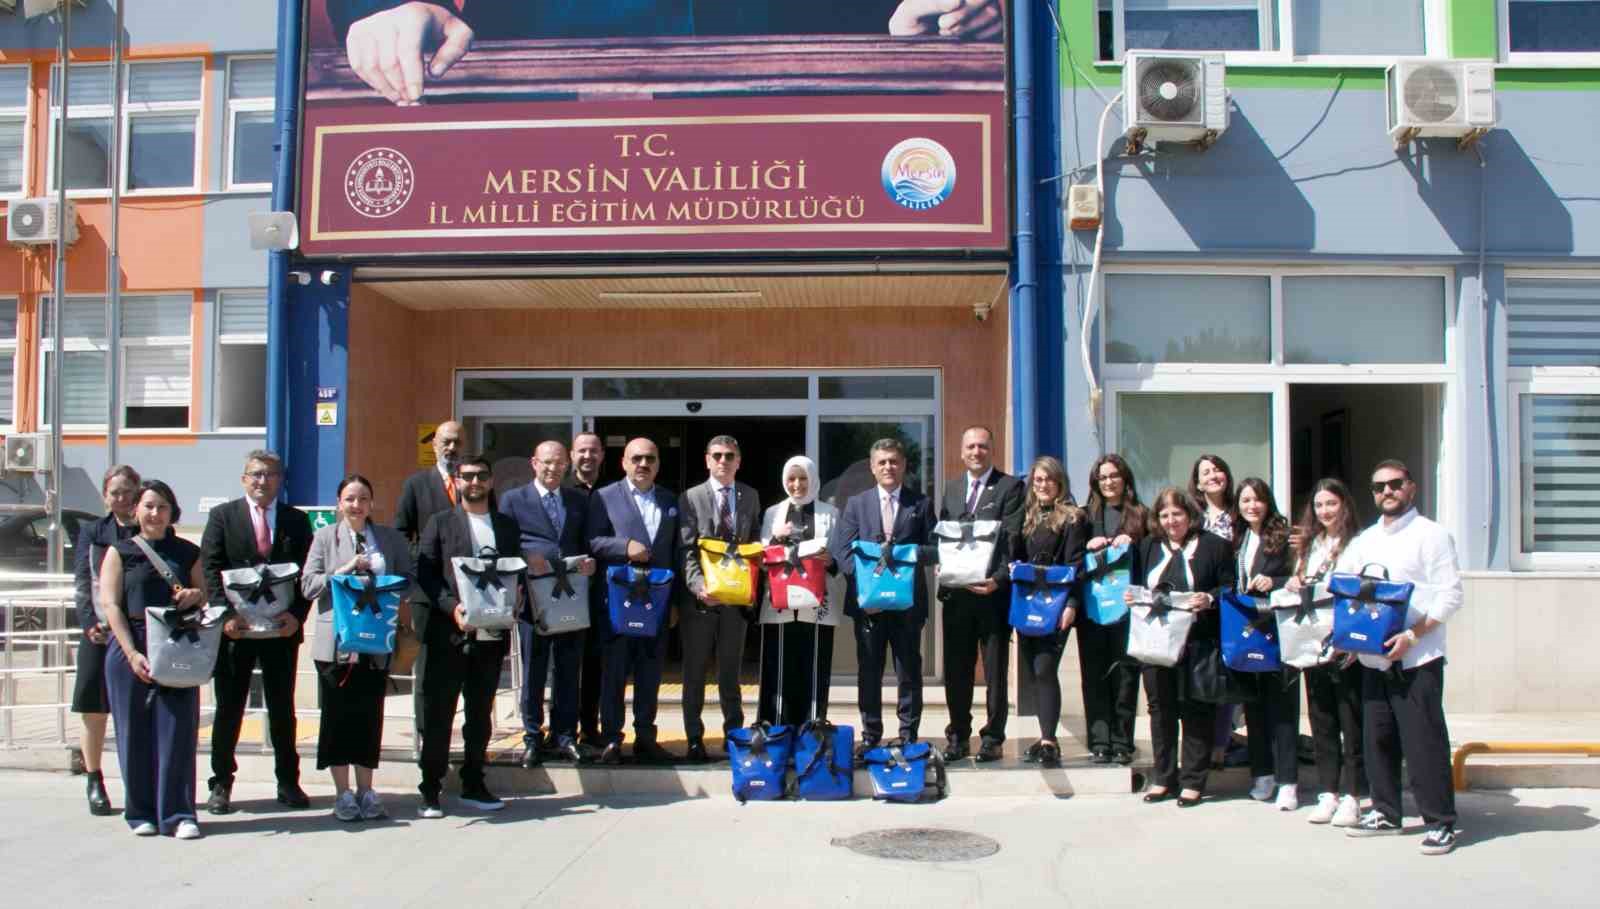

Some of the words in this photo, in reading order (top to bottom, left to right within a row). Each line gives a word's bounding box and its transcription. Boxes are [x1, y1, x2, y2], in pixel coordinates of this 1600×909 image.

[613, 133, 676, 157] T.C.
[483, 164, 629, 193] MERSİN
[642, 160, 807, 191] VALİLİĞİ
[429, 201, 454, 225] İL
[462, 199, 539, 224] MİLLİ
[551, 199, 656, 223] EĞİTİM
[666, 195, 865, 221] MÜDÜRLÜĞÜ
